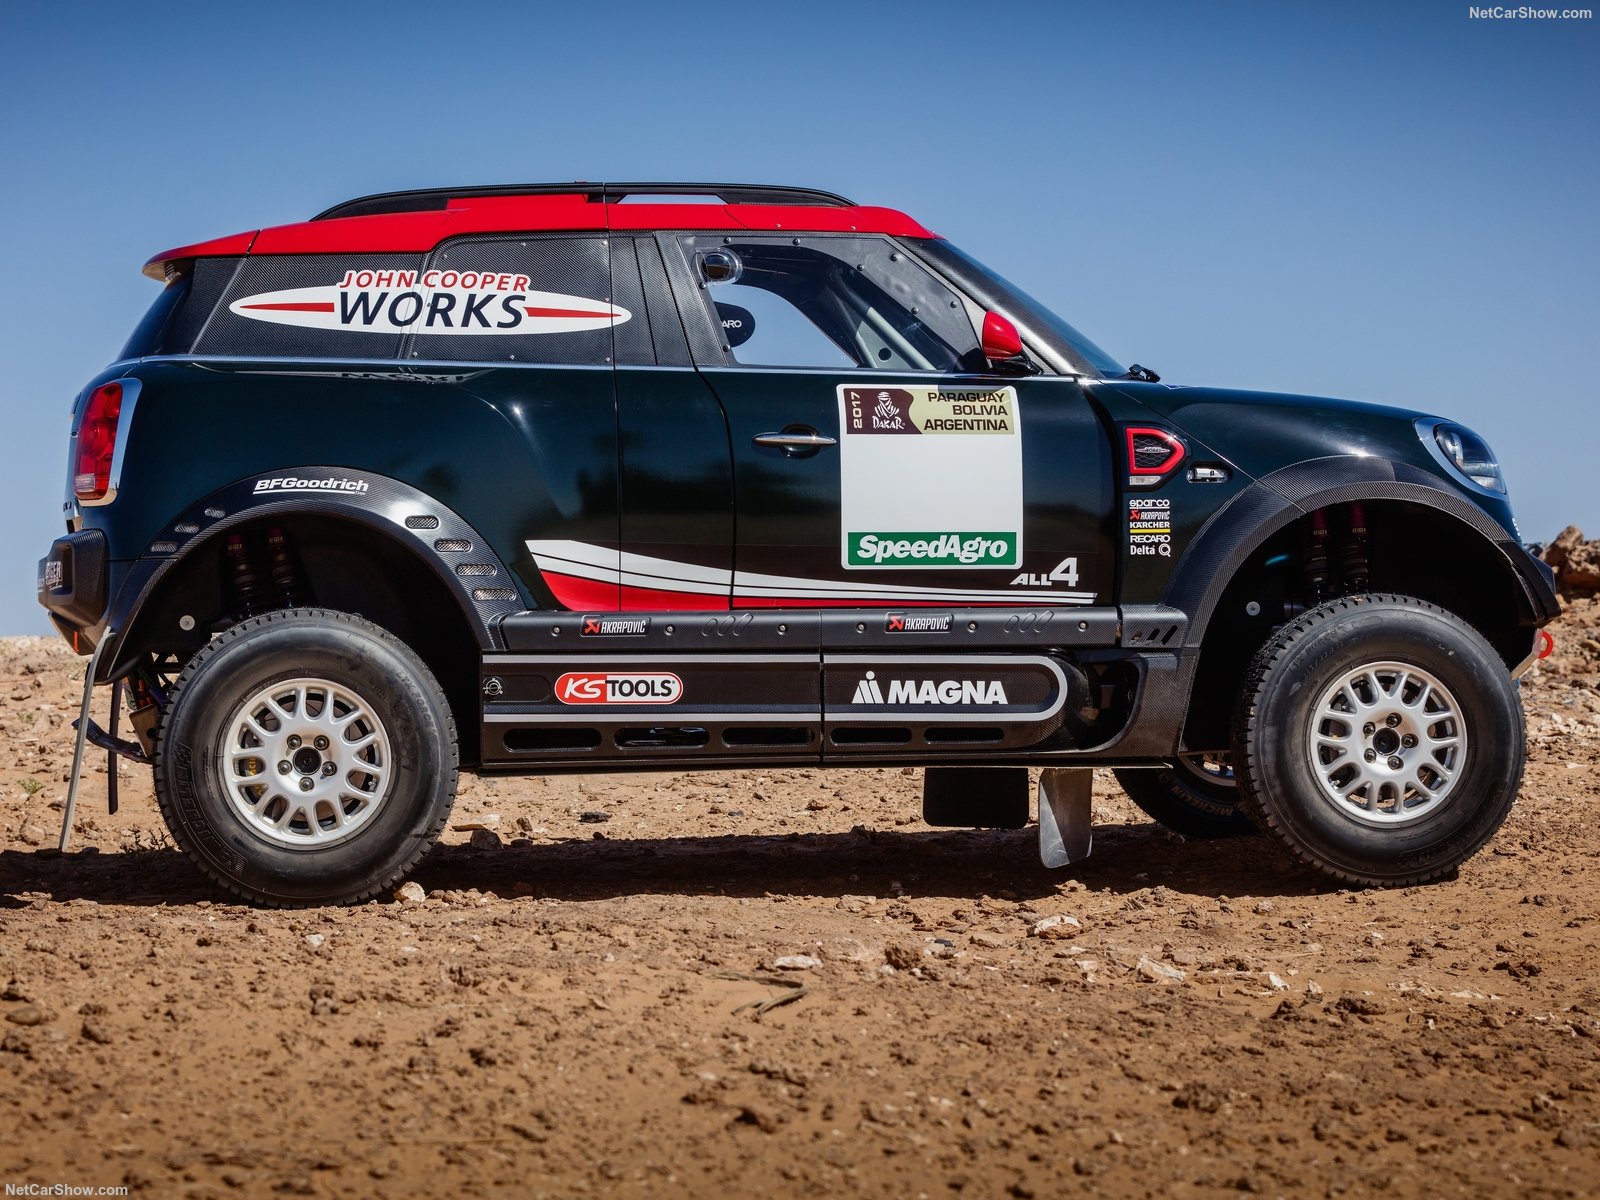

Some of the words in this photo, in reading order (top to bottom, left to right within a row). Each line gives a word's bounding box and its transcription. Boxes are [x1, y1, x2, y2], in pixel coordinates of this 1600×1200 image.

[339, 272, 415, 289] JOHN
[423, 272, 529, 292] COOPER
[340, 291, 526, 329] WORKS
[927, 392, 1005, 403] PARAGUAY
[850, 391, 863, 429] 2017
[952, 405, 1008, 416] BOLIVIA
[872, 415, 904, 430] DAKAR
[923, 419, 1009, 431] ARGENTINA
[254, 477, 369, 492] BFGoodrich
[1129, 499, 1170, 509] sparco
[1130, 534, 1171, 543] RECARO
[857, 534, 1008, 564] SpeedAgro
[1130, 545, 1155, 556] Delta
[1009, 557, 1079, 587] ALL4
[605, 679, 672, 697] TOOLS
[887, 680, 1009, 704] MAGNA
